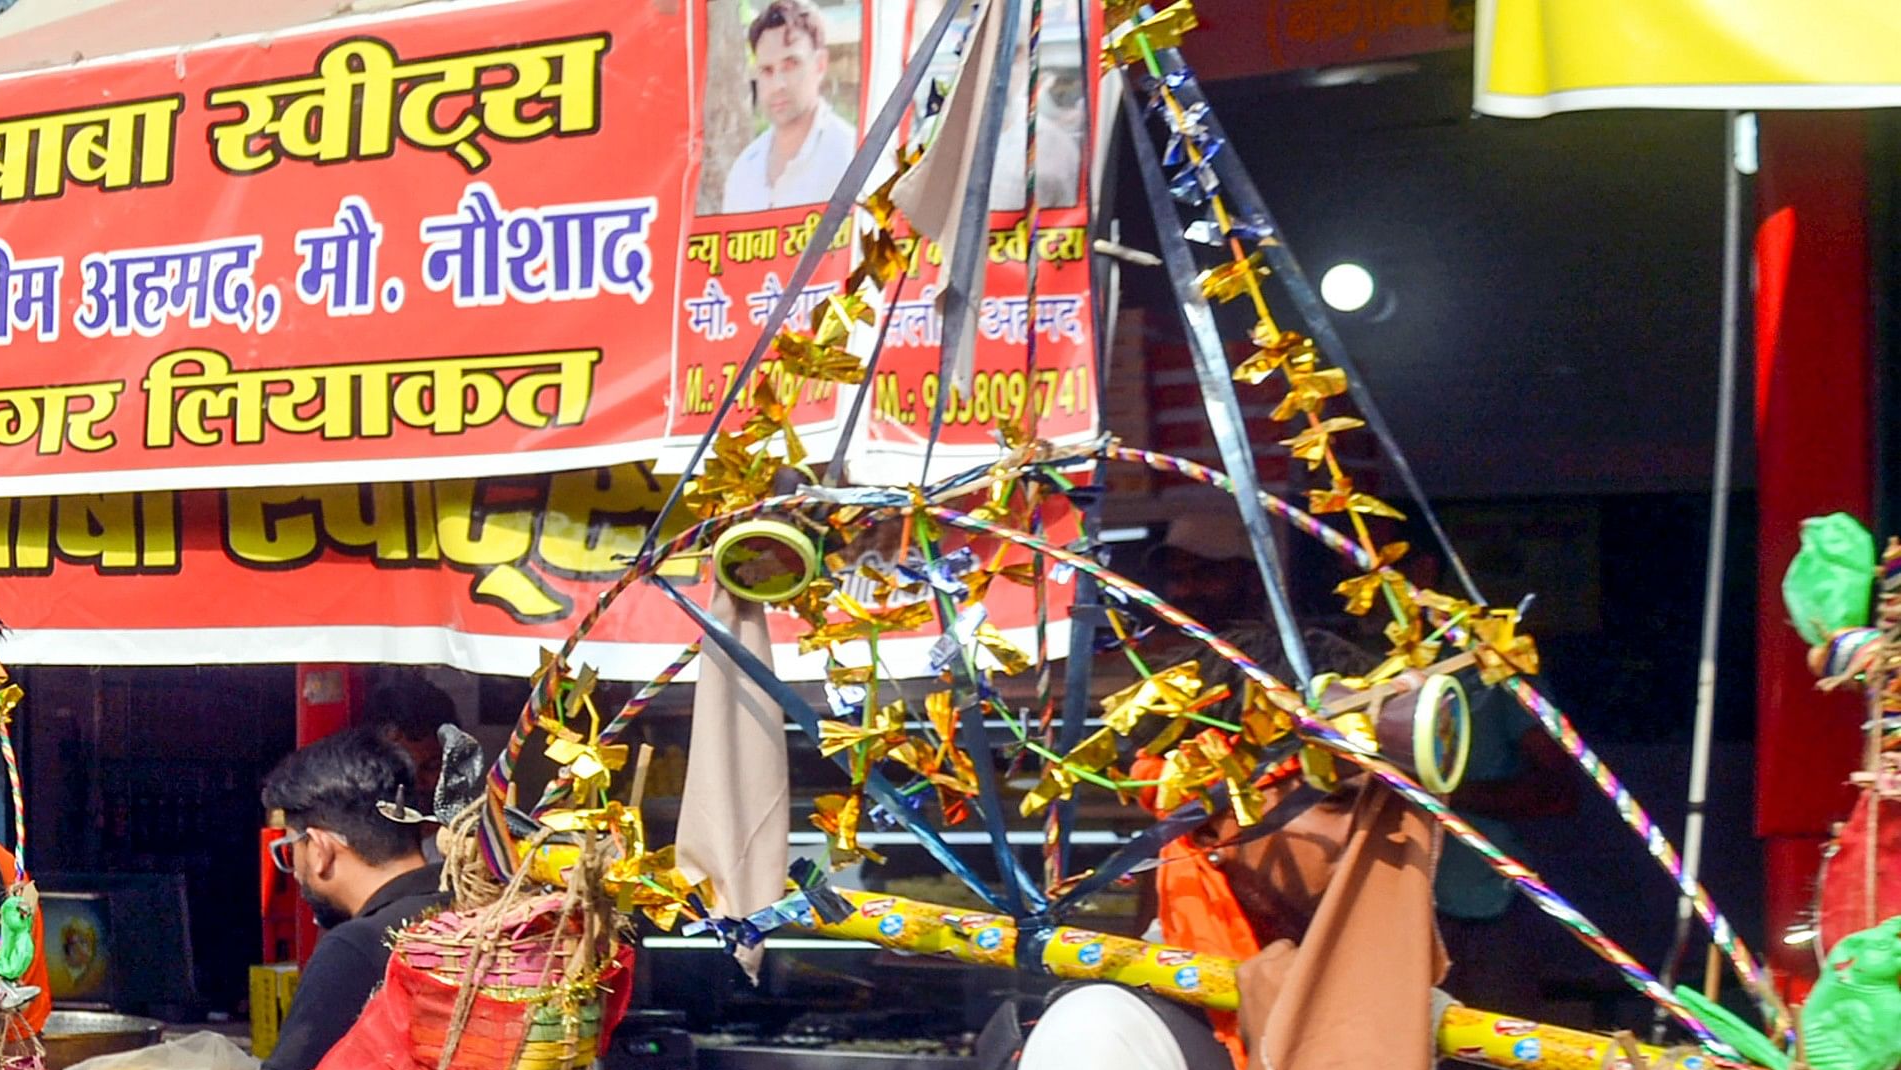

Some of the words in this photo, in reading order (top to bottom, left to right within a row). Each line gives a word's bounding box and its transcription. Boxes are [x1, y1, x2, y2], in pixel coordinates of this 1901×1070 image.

[205, 32, 612, 175] स्वीट्स
[76, 240, 278, 331] अहमद,
[299, 203, 401, 308] मौ.
[424, 190, 652, 299] नौशाद
[142, 347, 603, 449] लियाकत
